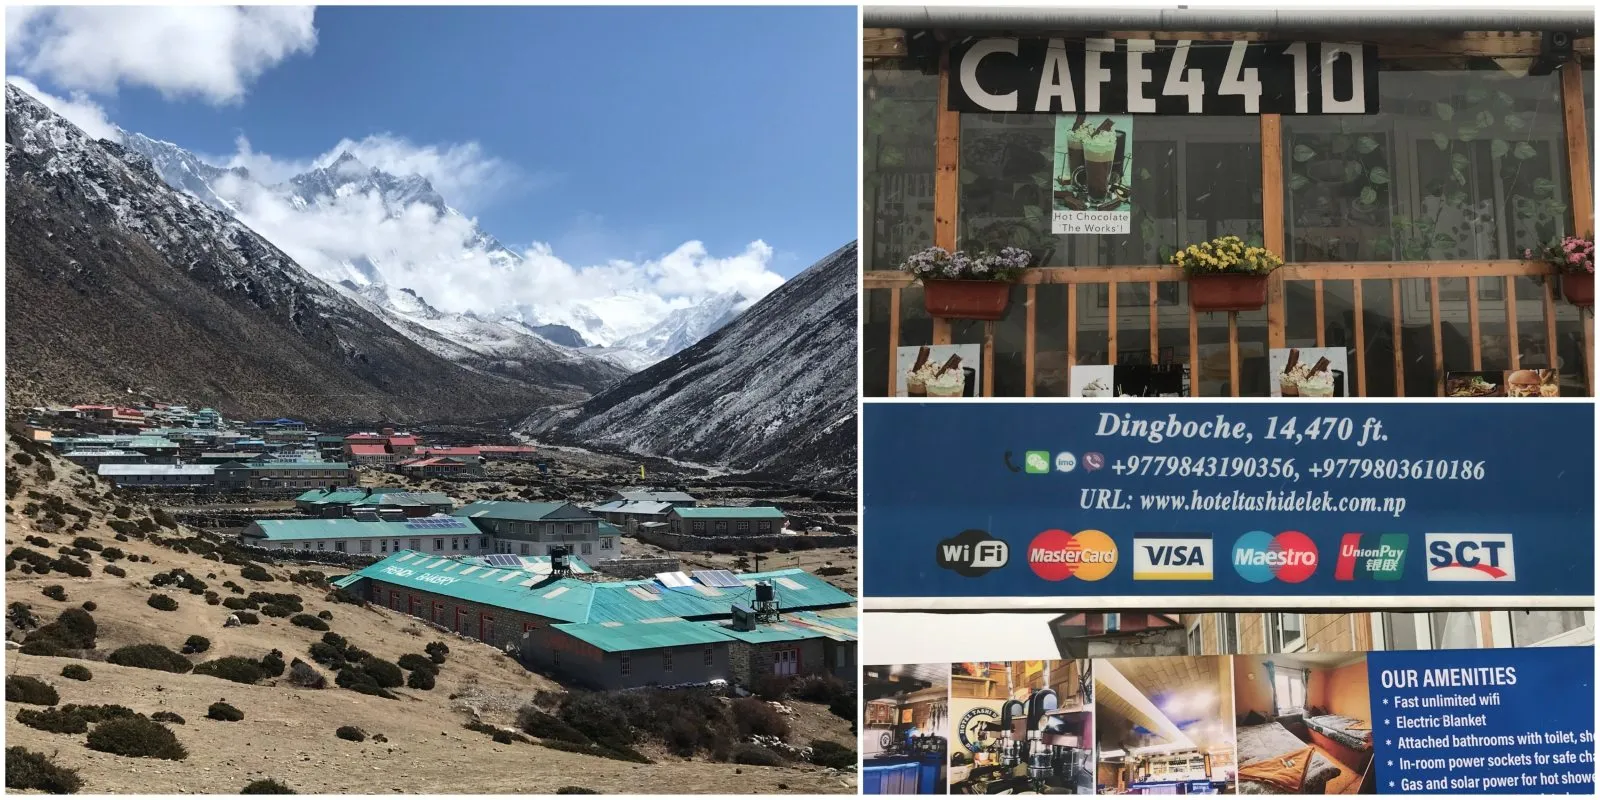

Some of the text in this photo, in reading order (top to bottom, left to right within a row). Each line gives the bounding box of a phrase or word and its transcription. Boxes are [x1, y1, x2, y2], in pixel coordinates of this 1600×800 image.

[1054, 212, 1129, 221] Hot Chocolate
[1095, 412, 1388, 447] Dingboche, 14,470 ft.
[1057, 458, 1074, 467] imo
[1111, 455, 1486, 482] +9779843190356, +9779803610186
[1080, 488, 1407, 518] URL: www.hoteltashidelek.com.np
[1030, 547, 1116, 564] MasterCard
[1142, 545, 1205, 566] VISA
[1234, 548, 1317, 566] Maestro
[1342, 544, 1404, 562] UnionPay
[1429, 540, 1506, 568] SCT
[1365, 558, 1398, 572] 银联
[1381, 666, 1517, 688] OUR AMENITIES
[1394, 692, 1500, 708] Fast unlimited wifi
[960, 713, 972, 734] HOTEL
[1396, 713, 1487, 728] Electric Blanket
[1398, 730, 1595, 749] Attached bathrooms with toilet, sh
[1399, 757, 1445, 770] In-room
[1448, 757, 1485, 771] power
[1488, 753, 1532, 767] sockets
[1534, 752, 1550, 764] for
[1553, 750, 1577, 763] safe
[1401, 778, 1424, 791] Gas
[1426, 776, 1448, 790] and
[1450, 775, 1480, 789] solar
[1483, 776, 1519, 791] power
[1521, 773, 1537, 786] for
[1540, 772, 1559, 785] hot
